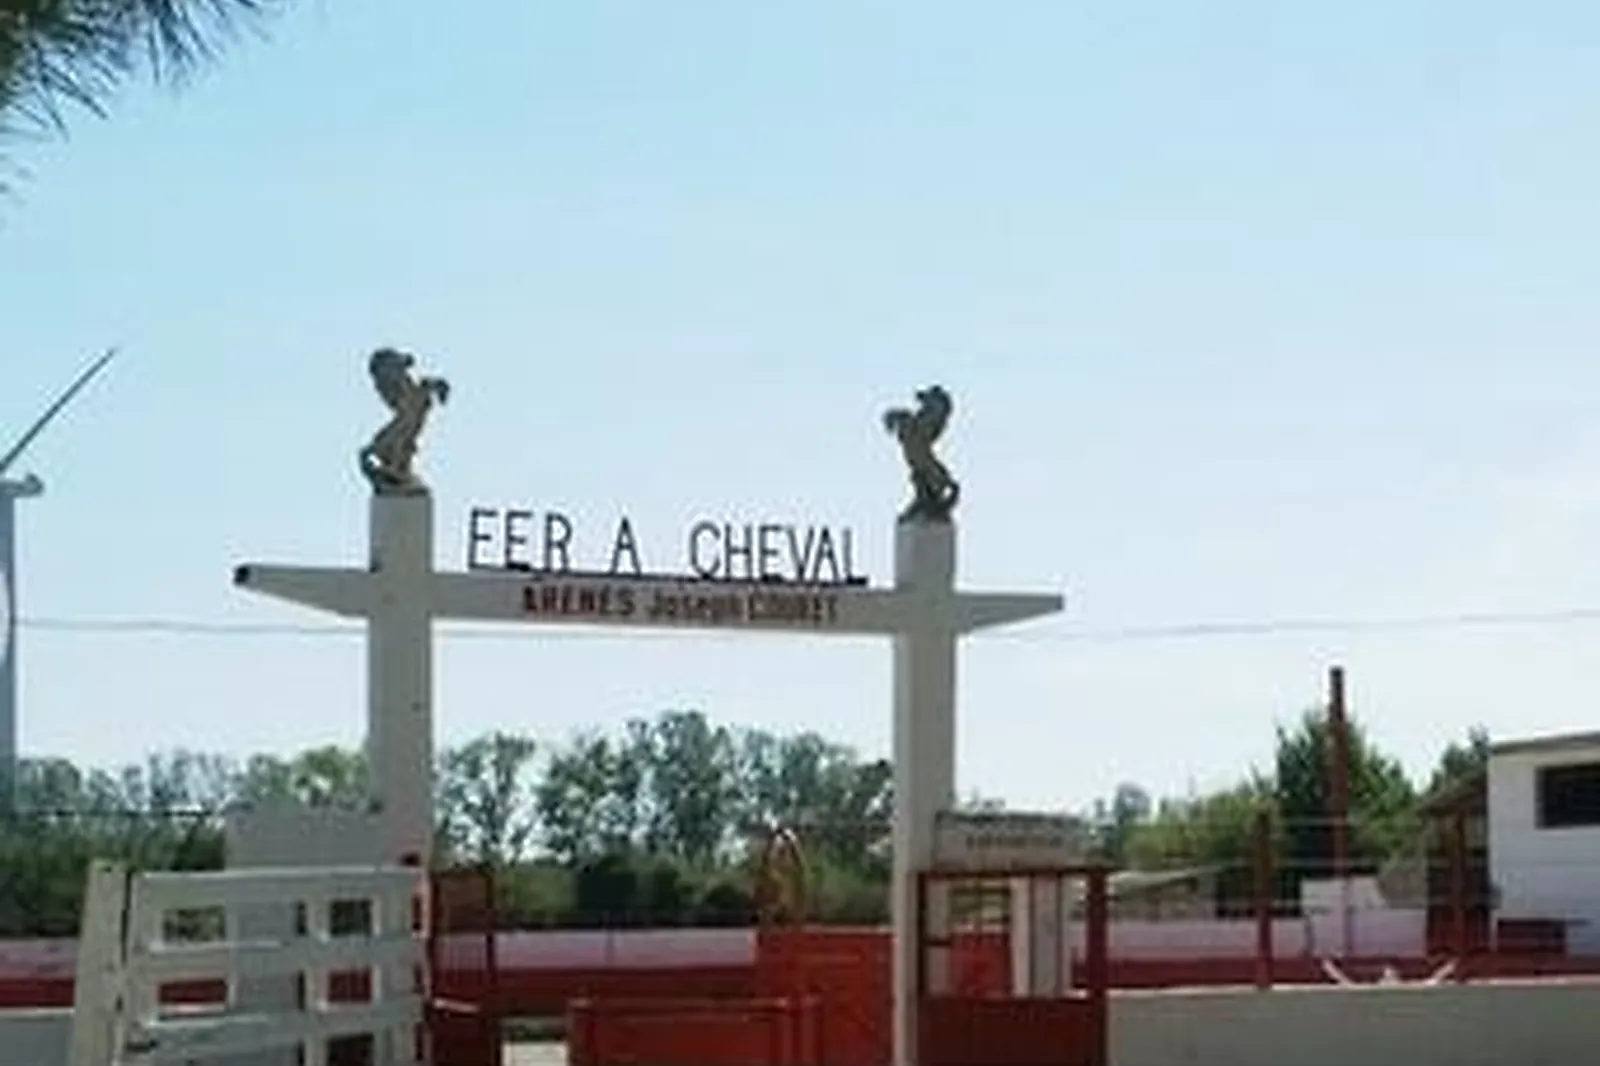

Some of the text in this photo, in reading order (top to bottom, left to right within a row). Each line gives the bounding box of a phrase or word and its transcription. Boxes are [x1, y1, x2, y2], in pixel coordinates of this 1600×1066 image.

[468, 508, 868, 586] FER A CHEVAL
